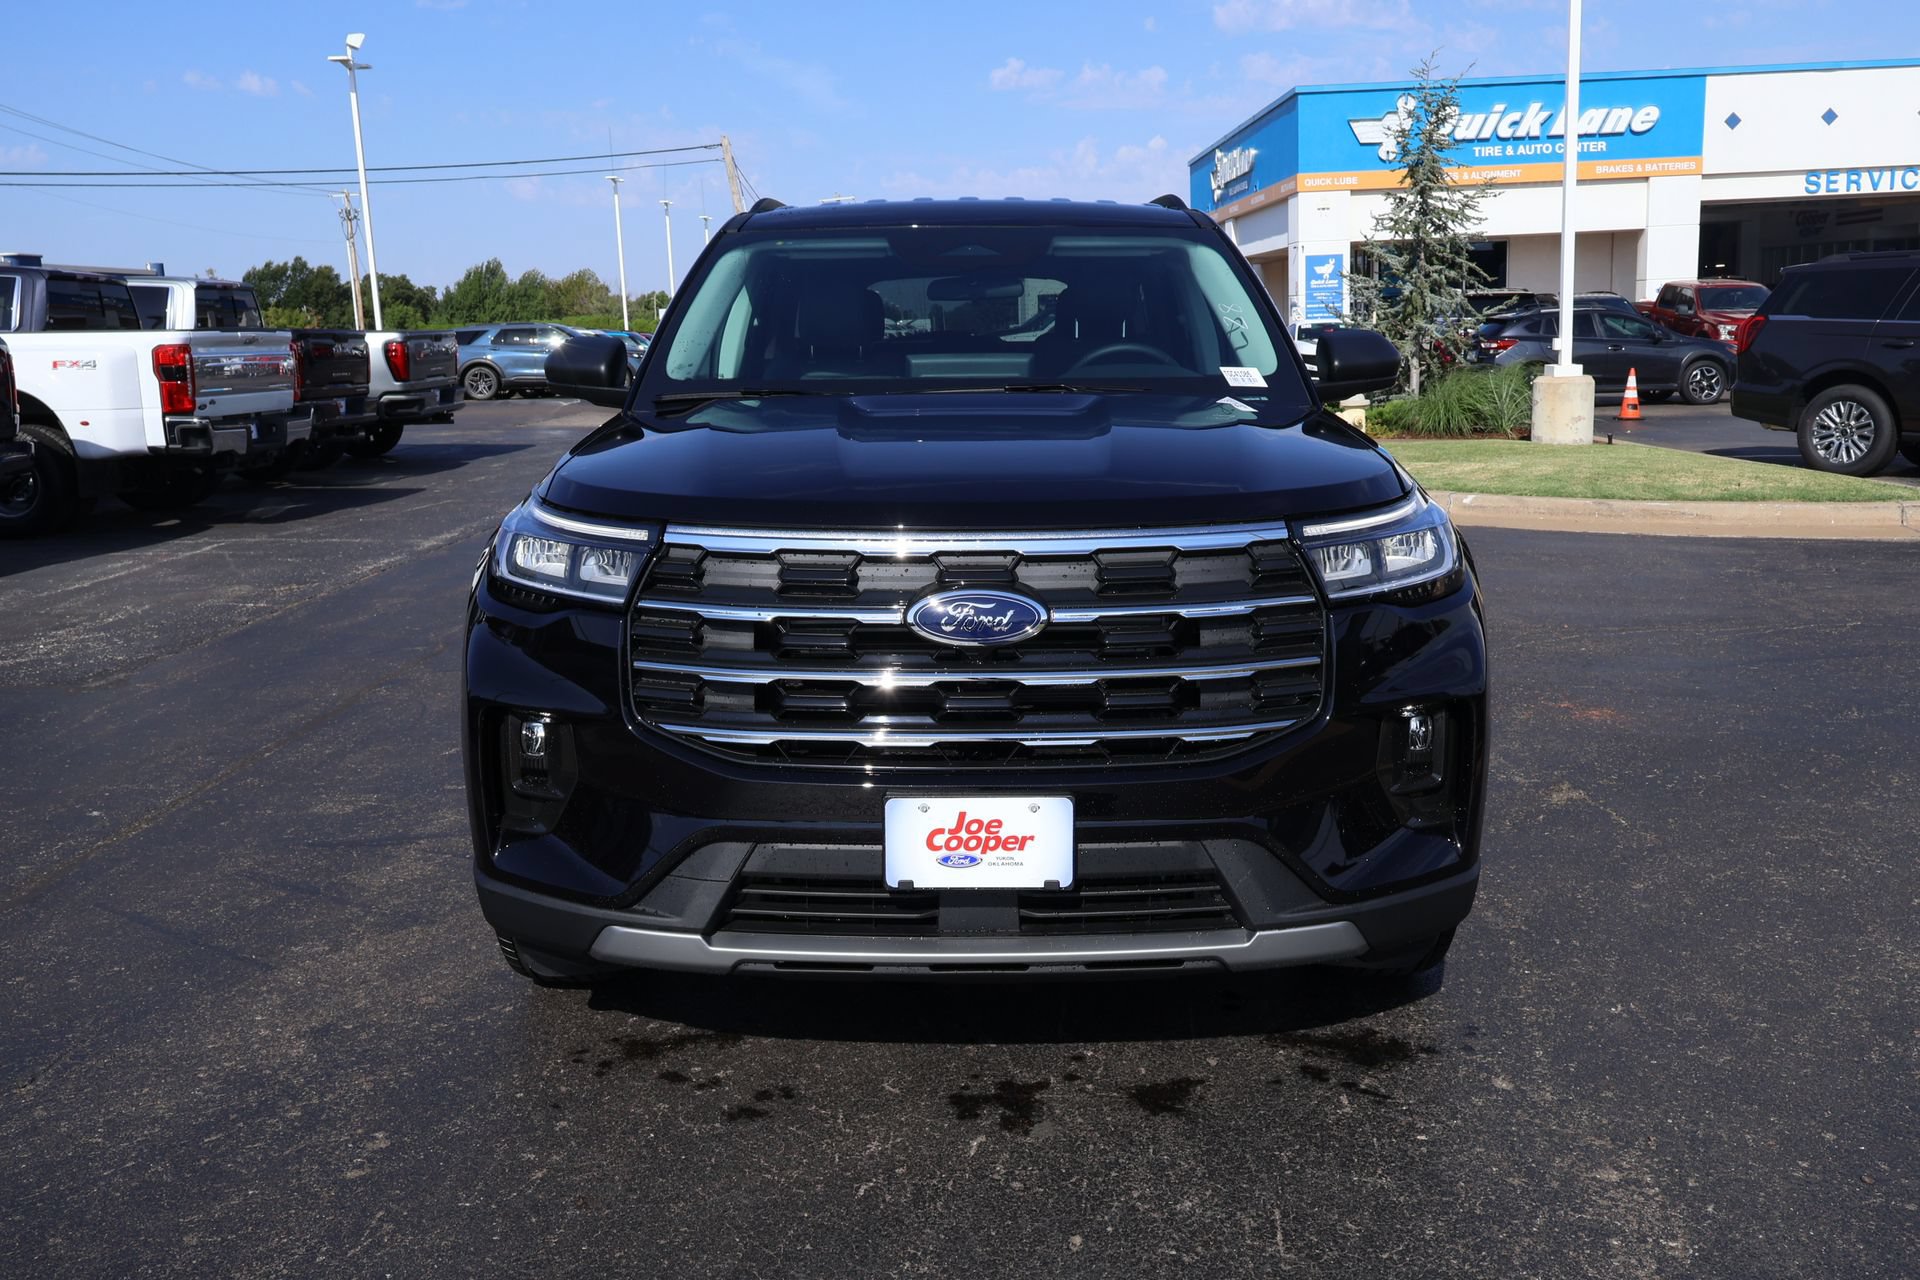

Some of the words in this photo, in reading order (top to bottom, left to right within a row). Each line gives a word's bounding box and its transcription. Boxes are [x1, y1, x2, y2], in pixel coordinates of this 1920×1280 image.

[1473, 146, 1502, 157] TIRE
[1505, 145, 1514, 156] &
[1517, 143, 1552, 155] AUTO
[1555, 141, 1606, 153] CNTER
[1471, 169, 1522, 179] ALIGNMENT
[1596, 164, 1633, 174] BRAKES
[1636, 164, 1642, 172] &
[1645, 162, 1696, 172] BATTERIES
[1304, 178, 1333, 187] QUICK
[1334, 176, 1359, 186] LUBE
[52, 360, 97, 369] FX4
[940, 602, 1016, 633] Ford
[947, 811, 1004, 835] Joe
[926, 828, 1035, 855] Cooper
[947, 854, 971, 865] Ford
